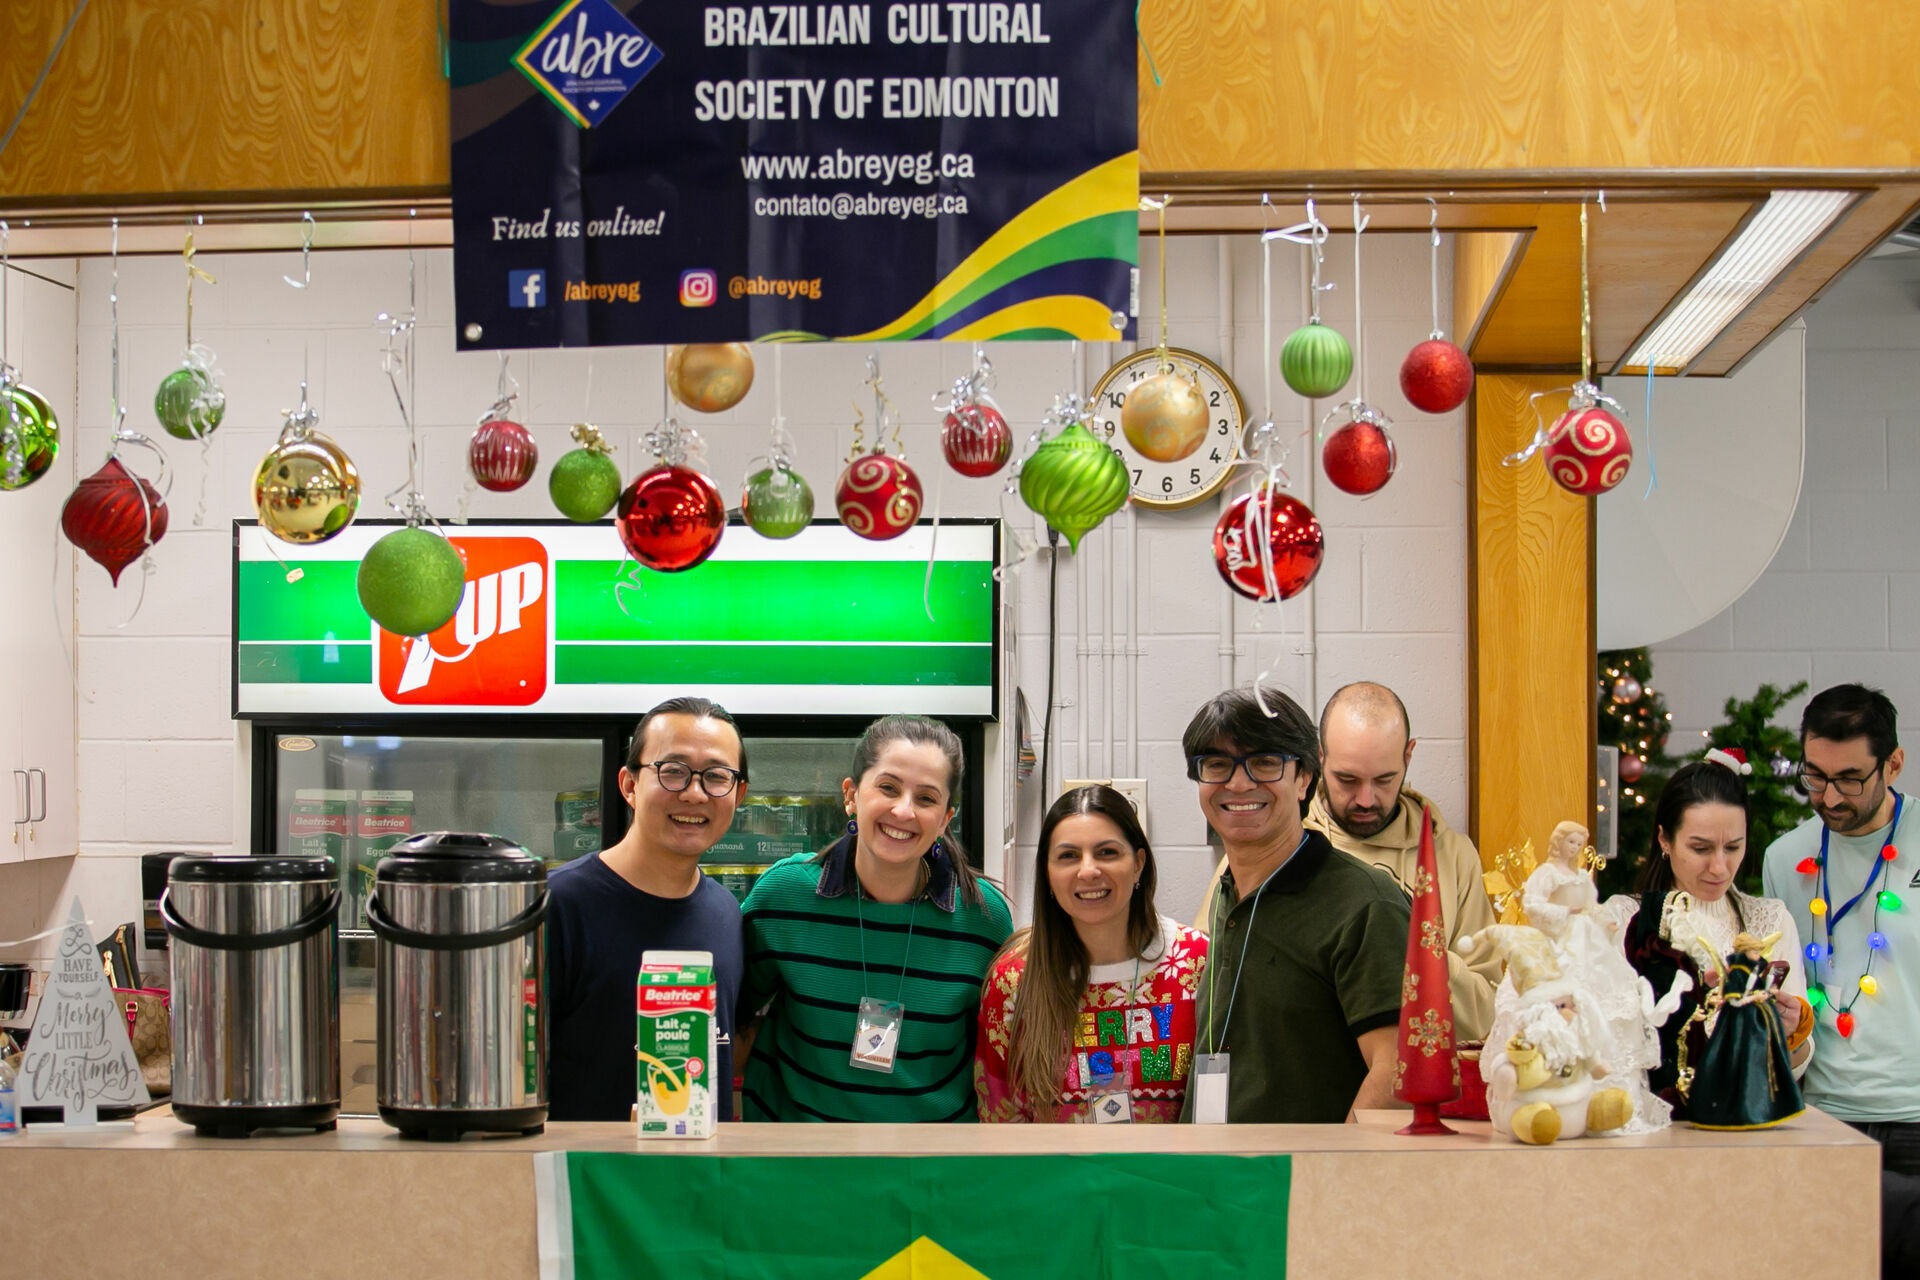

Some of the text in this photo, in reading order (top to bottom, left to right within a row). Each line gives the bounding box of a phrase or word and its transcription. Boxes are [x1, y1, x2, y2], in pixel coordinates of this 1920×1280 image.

[704, 3, 1051, 46] BRAZILIAN CULTURAL
[541, 11, 653, 78] abre
[694, 77, 1059, 121] SOCIETY OF EDMONTON
[740, 148, 976, 186] www.abreyeg.ca
[754, 192, 969, 220] contato@abreyeg.ca
[492, 206, 666, 241] Find us online!
[564, 280, 641, 303] /abreyeg
[728, 274, 822, 300] @abreyeg
[1209, 391, 1220, 407] 2
[1217, 419, 1229, 436] 3
[1209, 448, 1222, 464] 4
[1132, 469, 1144, 486] 7
[1161, 476, 1173, 493] 6
[1190, 469, 1201, 485] 5
[295, 817, 336, 826] Beatrice
[364, 818, 405, 827] Beatrice
[302, 838, 319, 848] Lait
[757, 841, 768, 852] 12
[63, 958, 93, 972] HAVE
[58, 971, 100, 983] YOURSELF
[645, 988, 702, 1002] Beatrice
[41, 1000, 114, 1055] Merry
[655, 1017, 691, 1030] Lait de
[1074, 1003, 1175, 1047] ERRY
[55, 1031, 94, 1050] LITTLE
[655, 1029, 691, 1042] poule
[25, 1051, 138, 1112] Christmas
